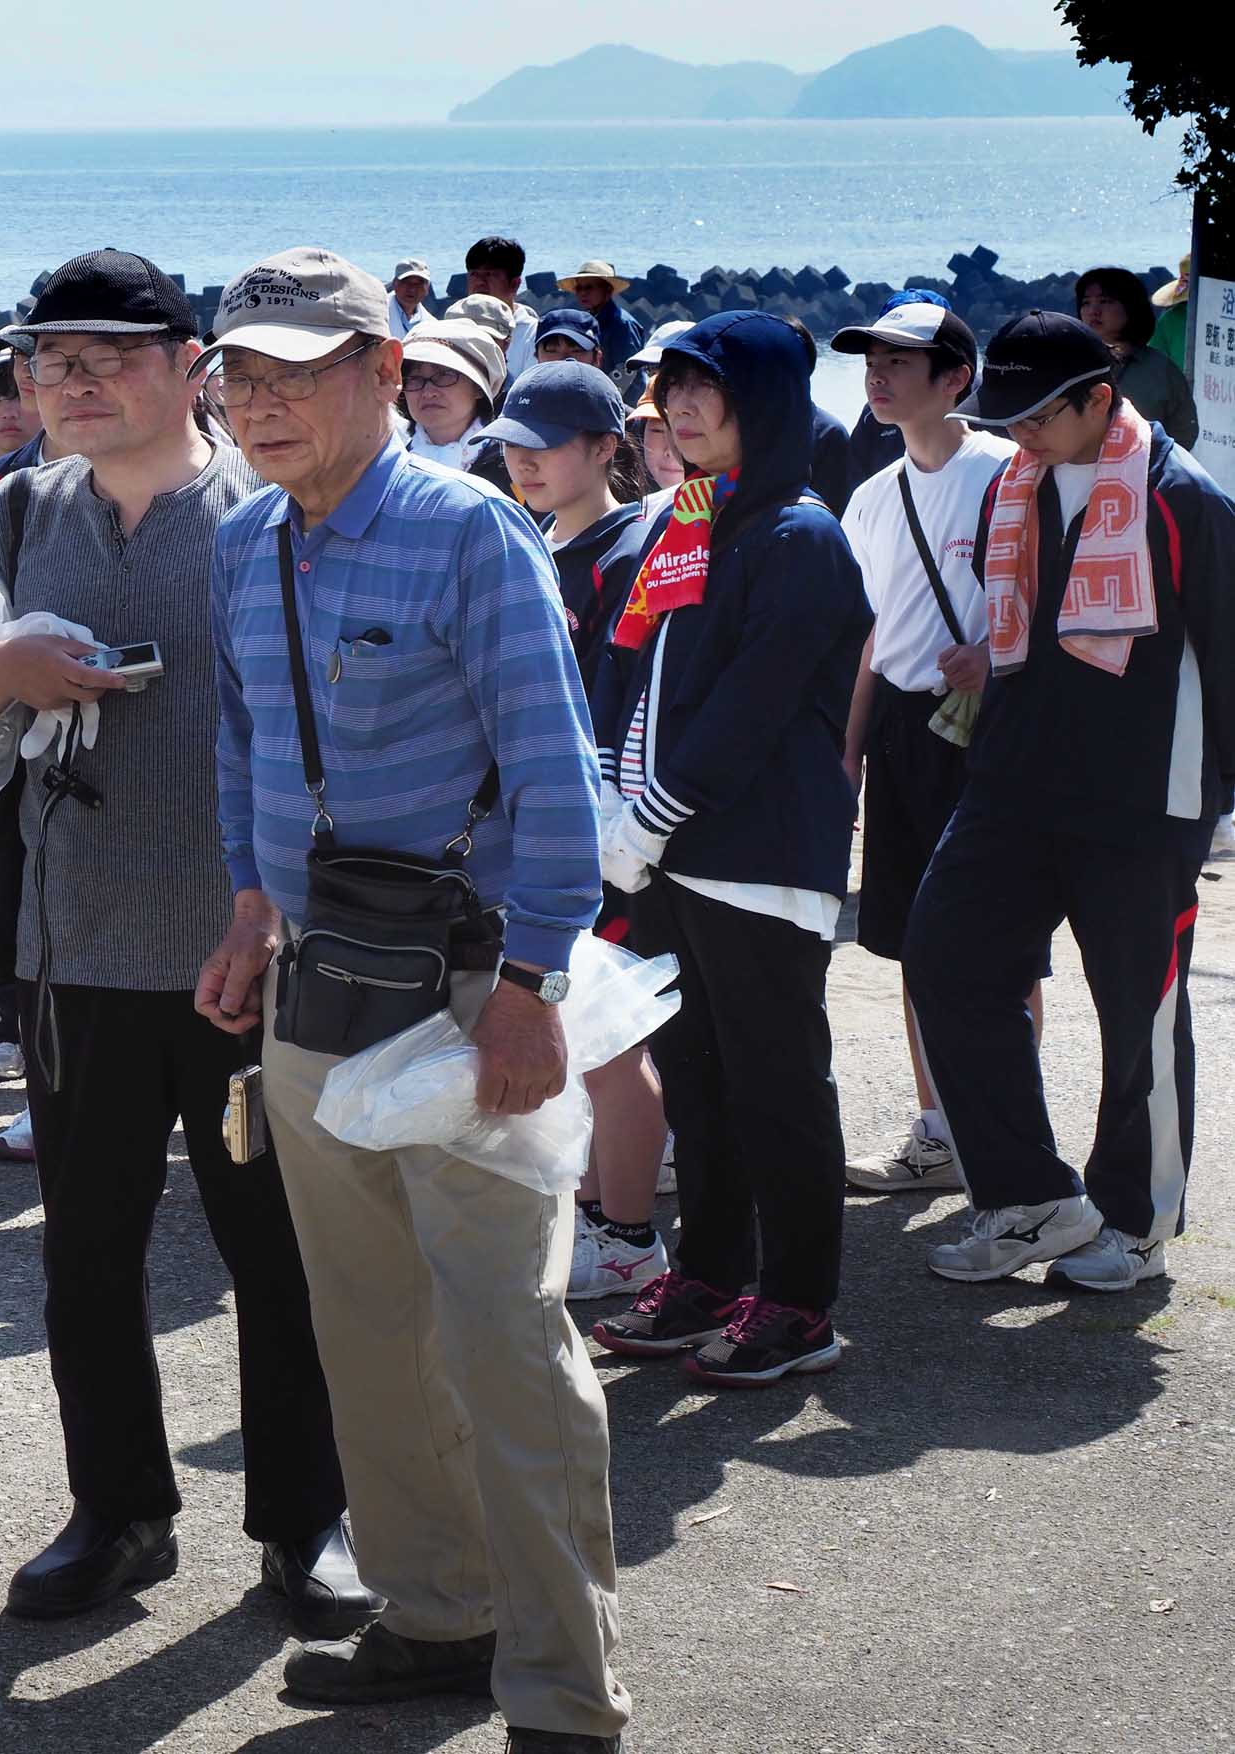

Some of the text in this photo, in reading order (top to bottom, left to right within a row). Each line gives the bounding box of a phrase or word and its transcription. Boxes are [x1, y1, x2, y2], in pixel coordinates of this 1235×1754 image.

[279, 269, 303, 288] Wave
[260, 284, 320, 301] DESIGNS
[267, 297, 295, 306] 1971
